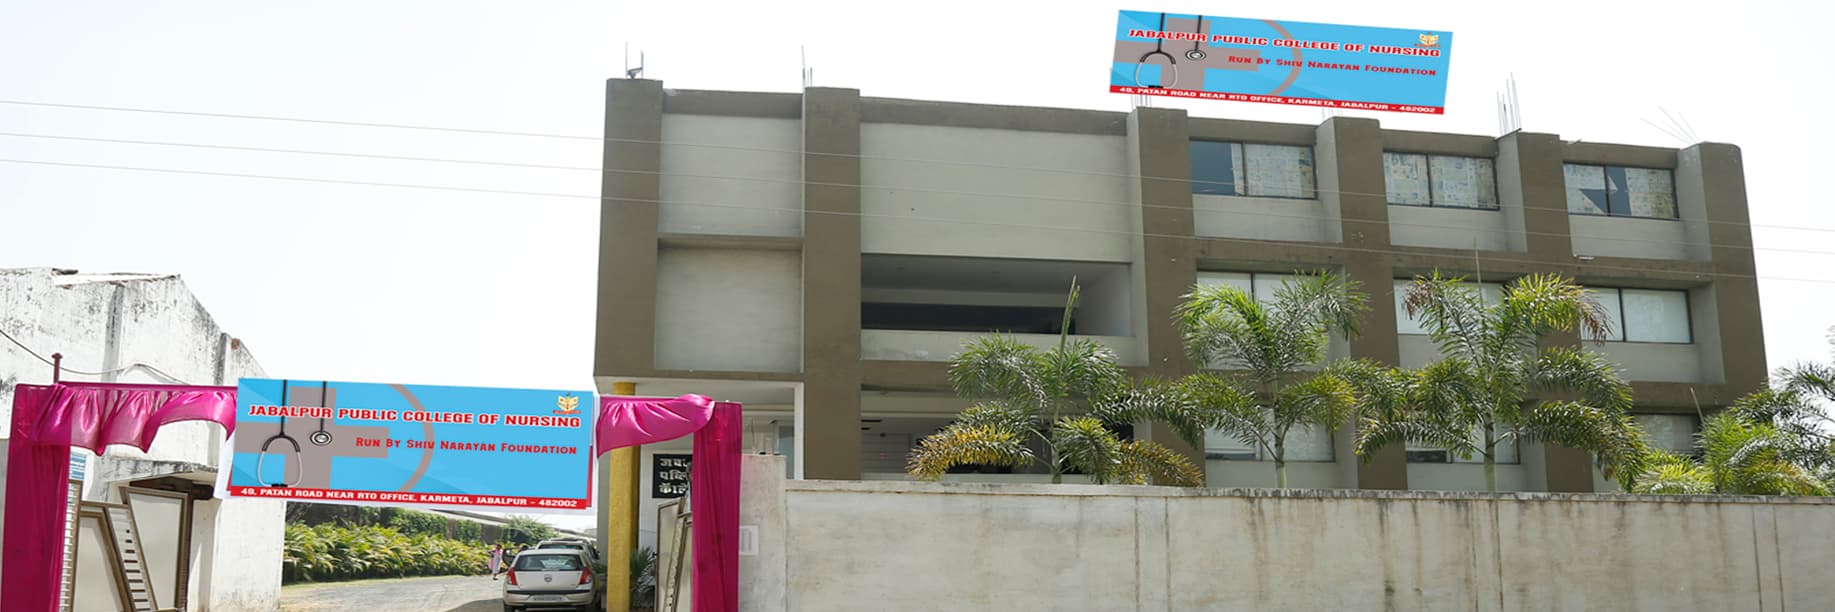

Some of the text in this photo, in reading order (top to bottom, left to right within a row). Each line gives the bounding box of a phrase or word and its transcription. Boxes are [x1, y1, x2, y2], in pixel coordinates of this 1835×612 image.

[1129, 29, 1440, 57] JABALPUR PUBLIC COLLEGE OF NURSING
[1228, 55, 1251, 64] RUN
[1276, 58, 1303, 67] SHIV
[1307, 61, 1360, 71] NARAYAN
[1365, 64, 1436, 76] FOUNDATION
[1137, 88, 1167, 96] PATAN
[1341, 102, 1388, 110] JABALPUR
[1399, 105, 1435, 113] 482002
[248, 405, 581, 428] JABALPUR PUBLIC COLLEGE OF NURSING
[355, 437, 577, 455] RUN BY SHIV NARAYAN FOUNDATION
[260, 489, 292, 497] PATAN
[294, 490, 323, 498] ROAD
[326, 491, 354, 499] NEAR
[357, 492, 377, 500] RTO
[476, 496, 527, 505] JABALPUR
[538, 499, 577, 507] 482002
